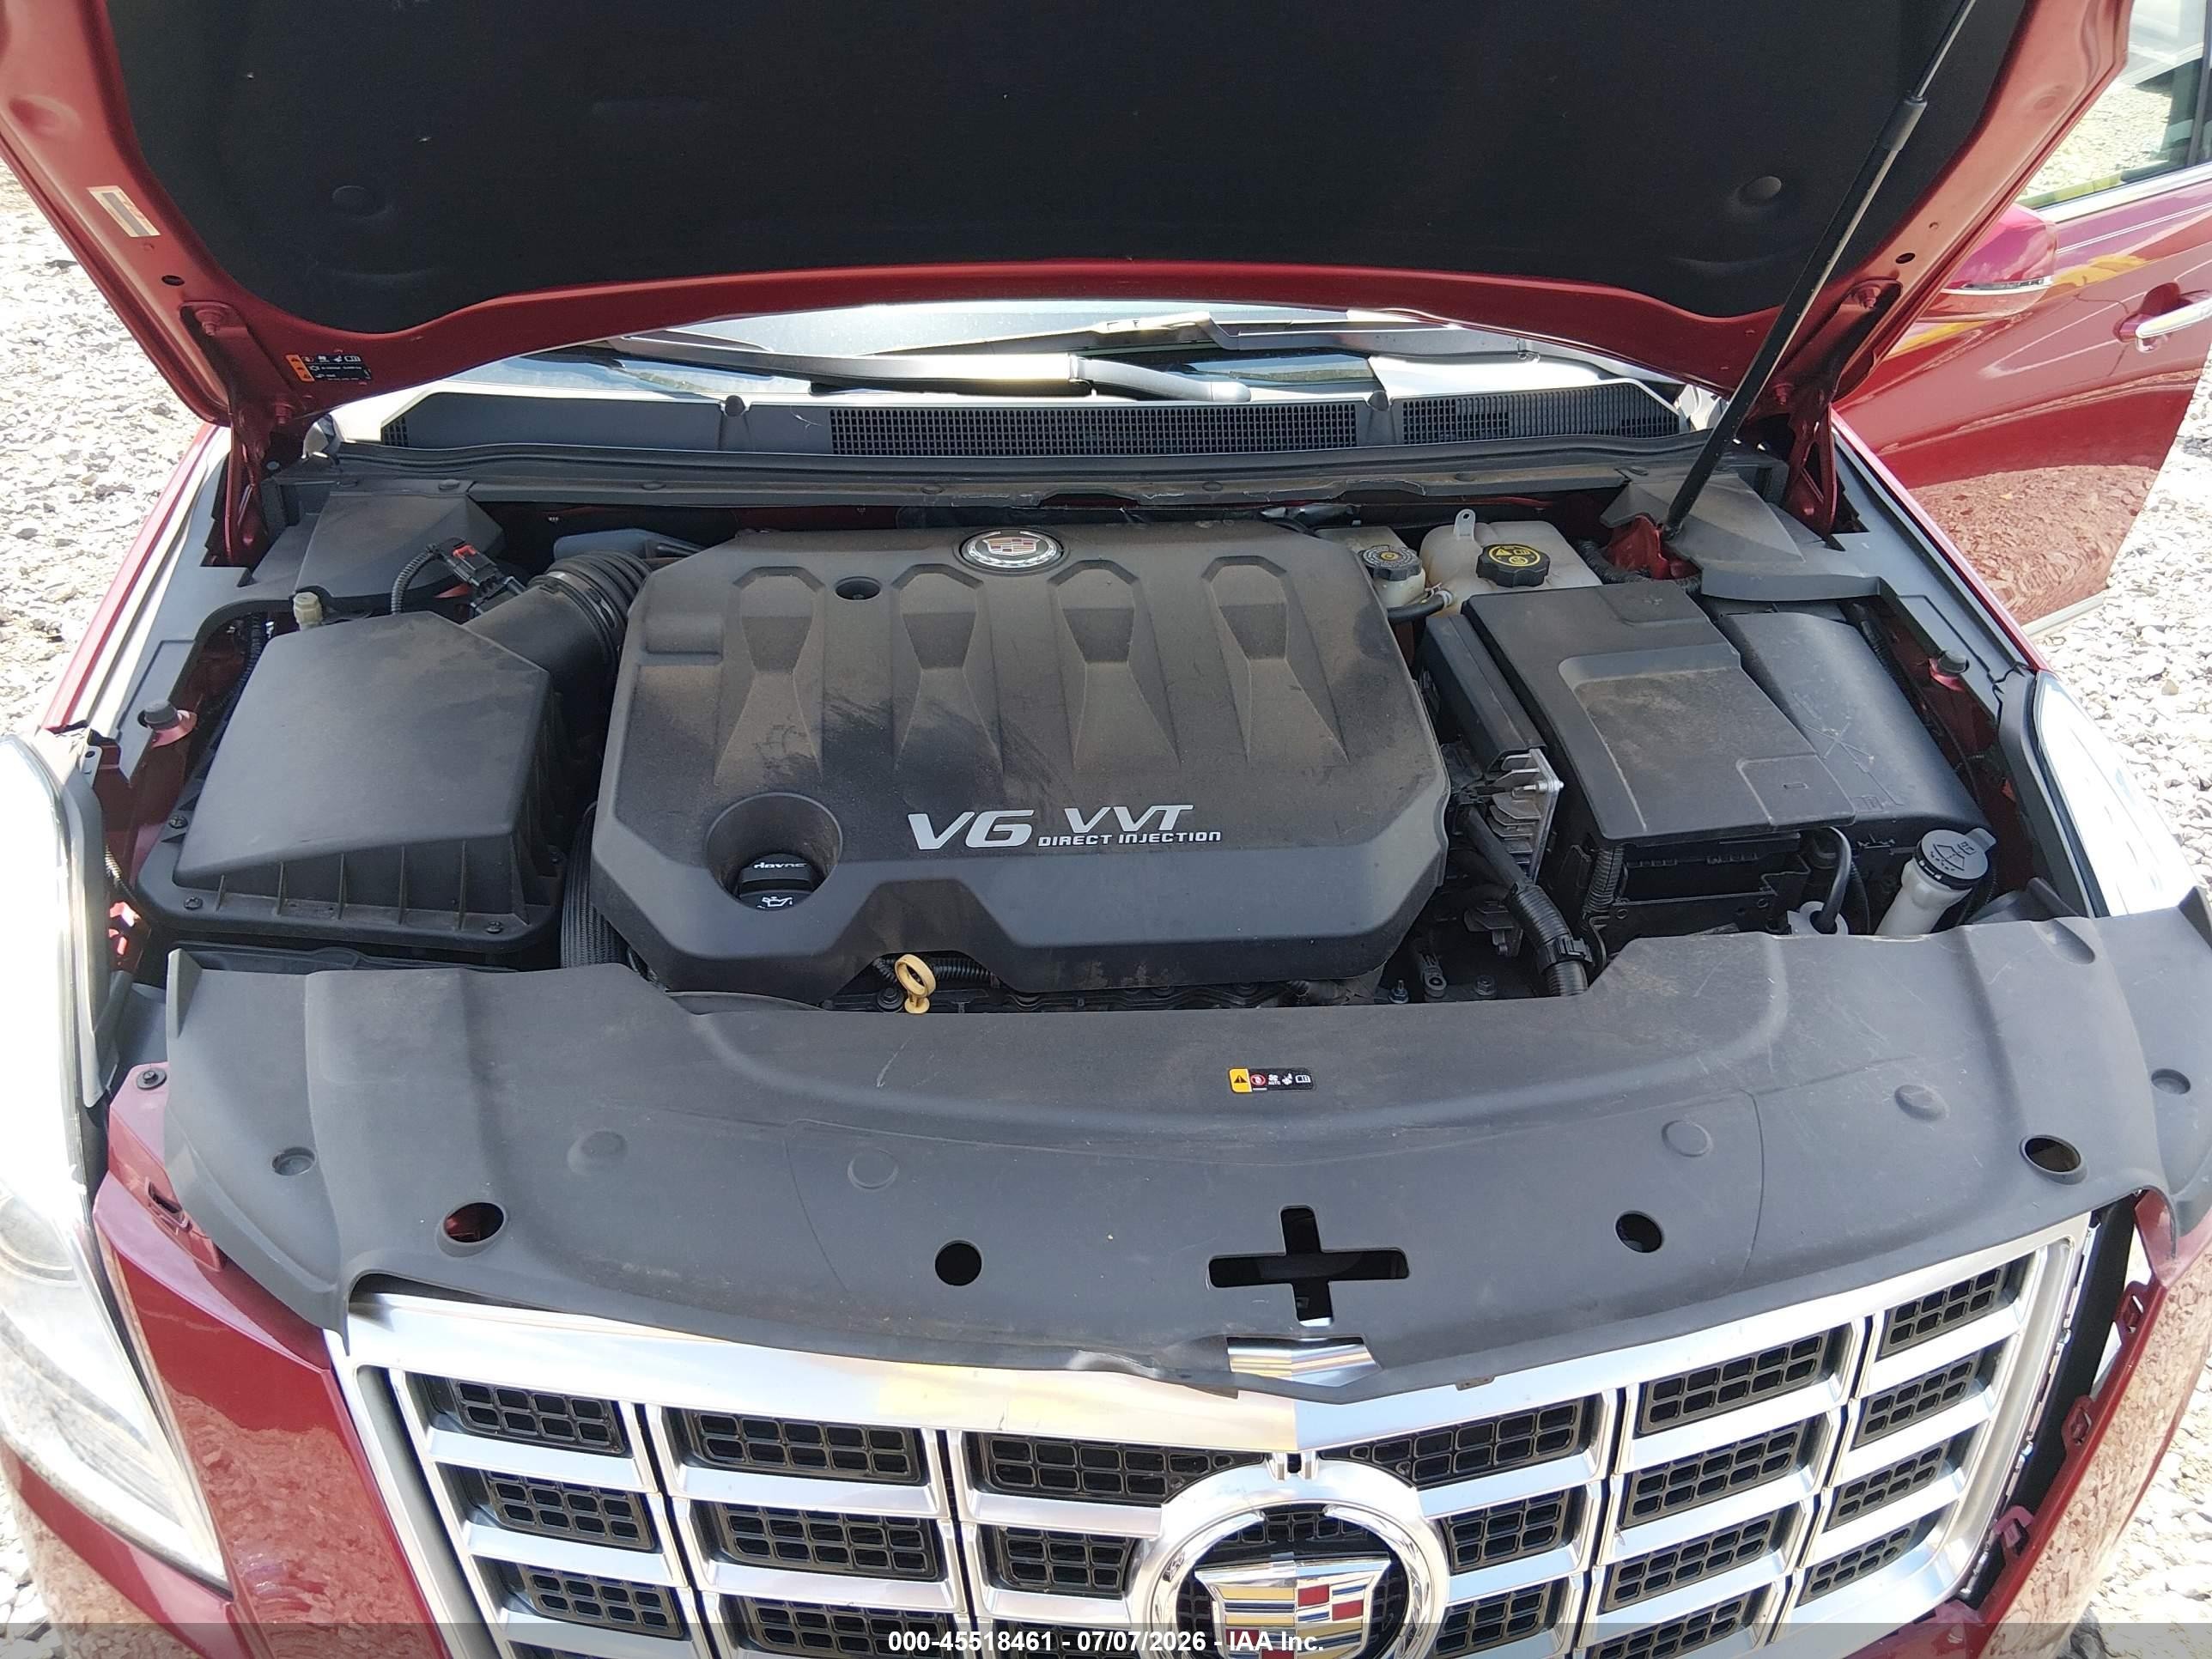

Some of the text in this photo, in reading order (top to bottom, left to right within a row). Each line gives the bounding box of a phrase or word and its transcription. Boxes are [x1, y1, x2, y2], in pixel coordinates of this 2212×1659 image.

[908, 805, 1194, 850] V6 VVT
[1037, 831, 1221, 847] DIRECT INJECTION
